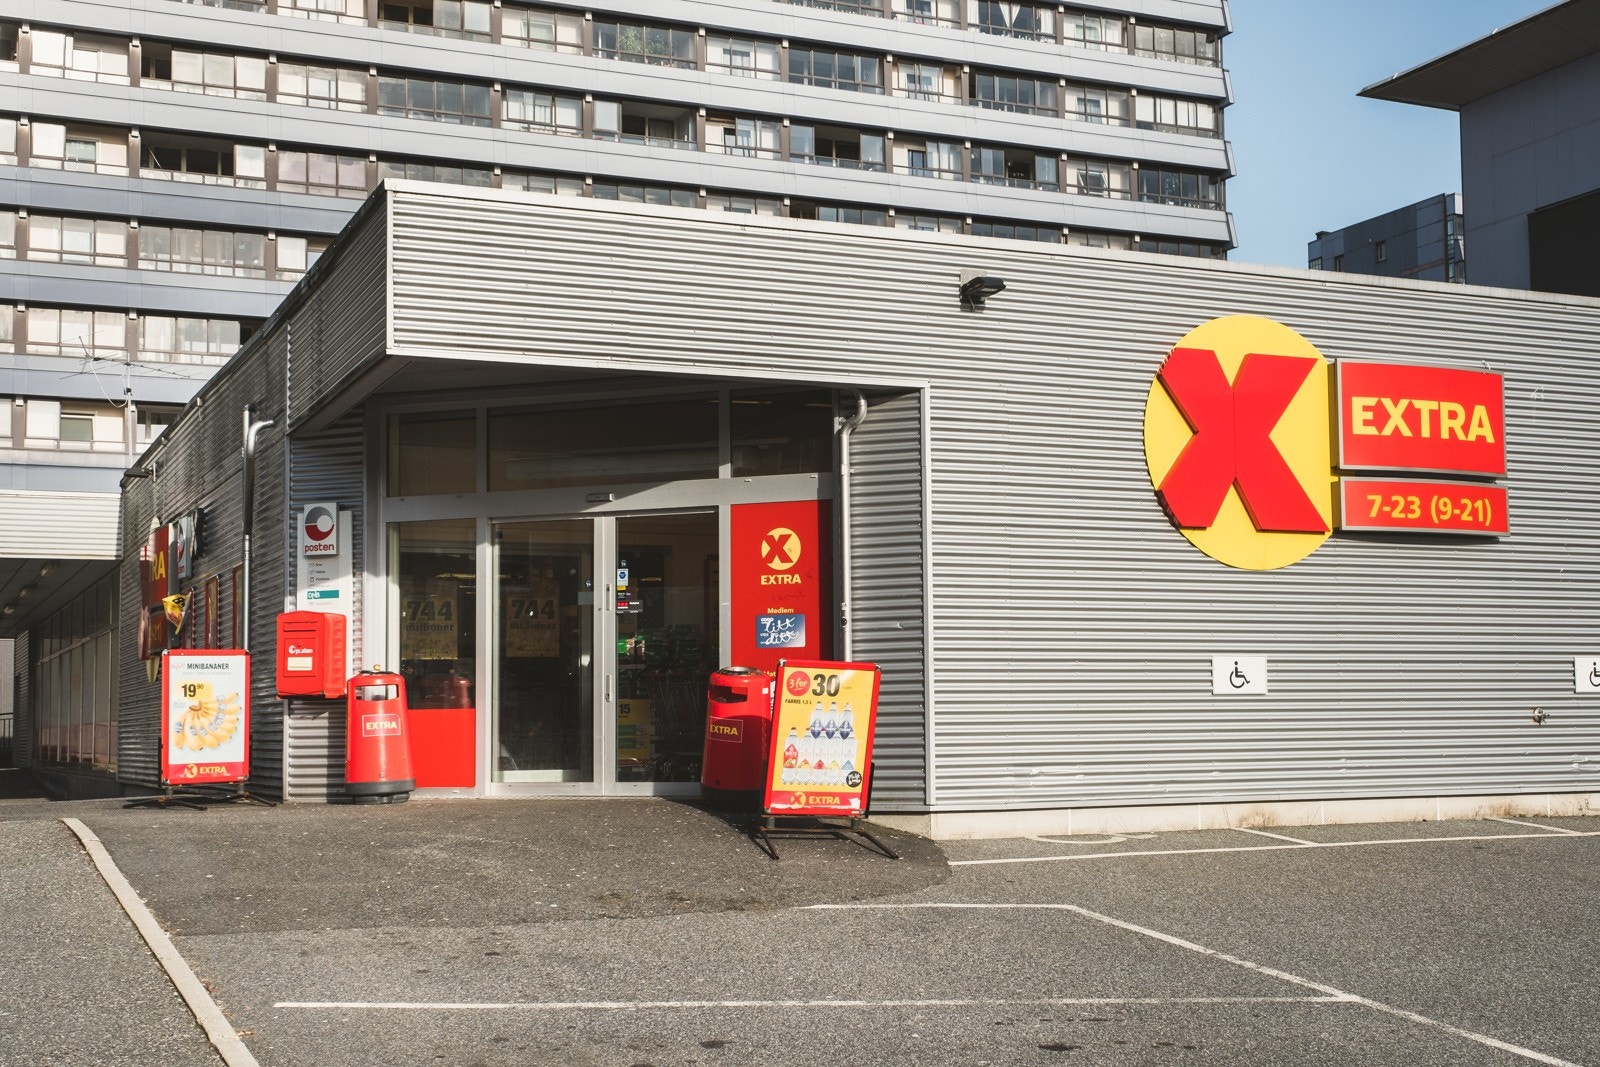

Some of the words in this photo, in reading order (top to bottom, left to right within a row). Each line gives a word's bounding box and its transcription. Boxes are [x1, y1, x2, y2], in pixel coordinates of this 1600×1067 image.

[1351, 396, 1496, 444] EXTRA
[1366, 494, 1422, 519] 7-23
[1430, 495, 1492, 527] (9-21)
[304, 543, 335, 554] posten
[761, 574, 802, 586] EXTRA
[406, 600, 453, 621] 744
[789, 679, 795, 689] 3
[795, 678, 808, 688] for
[811, 673, 841, 697] 30
[181, 684, 197, 698] 19
[618, 703, 631, 714] 15
[366, 721, 398, 731] EXTRA
[709, 724, 739, 736] EXTRA
[199, 766, 227, 774] EXTRA
[808, 796, 841, 805] EXTRA
